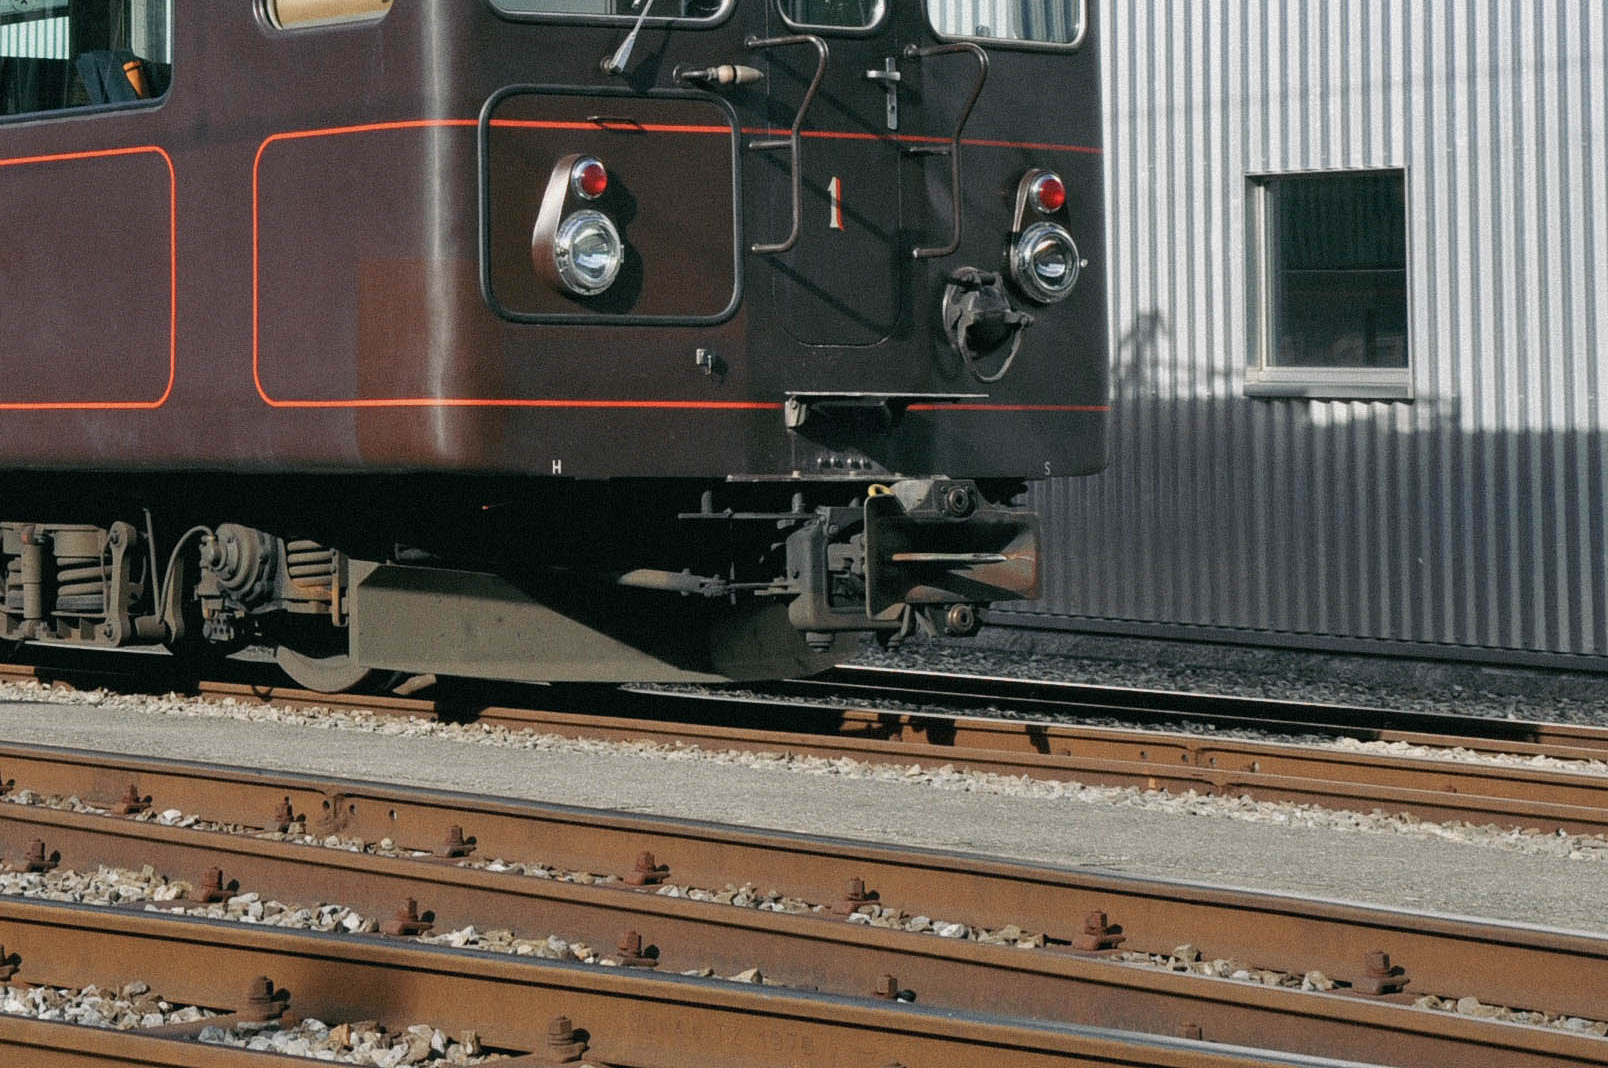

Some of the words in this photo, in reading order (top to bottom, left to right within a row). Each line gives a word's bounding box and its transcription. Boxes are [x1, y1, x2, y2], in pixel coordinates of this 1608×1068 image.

[827, 176, 845, 231] 1
[552, 459, 562, 475] H
[1044, 460, 1051, 476] S
